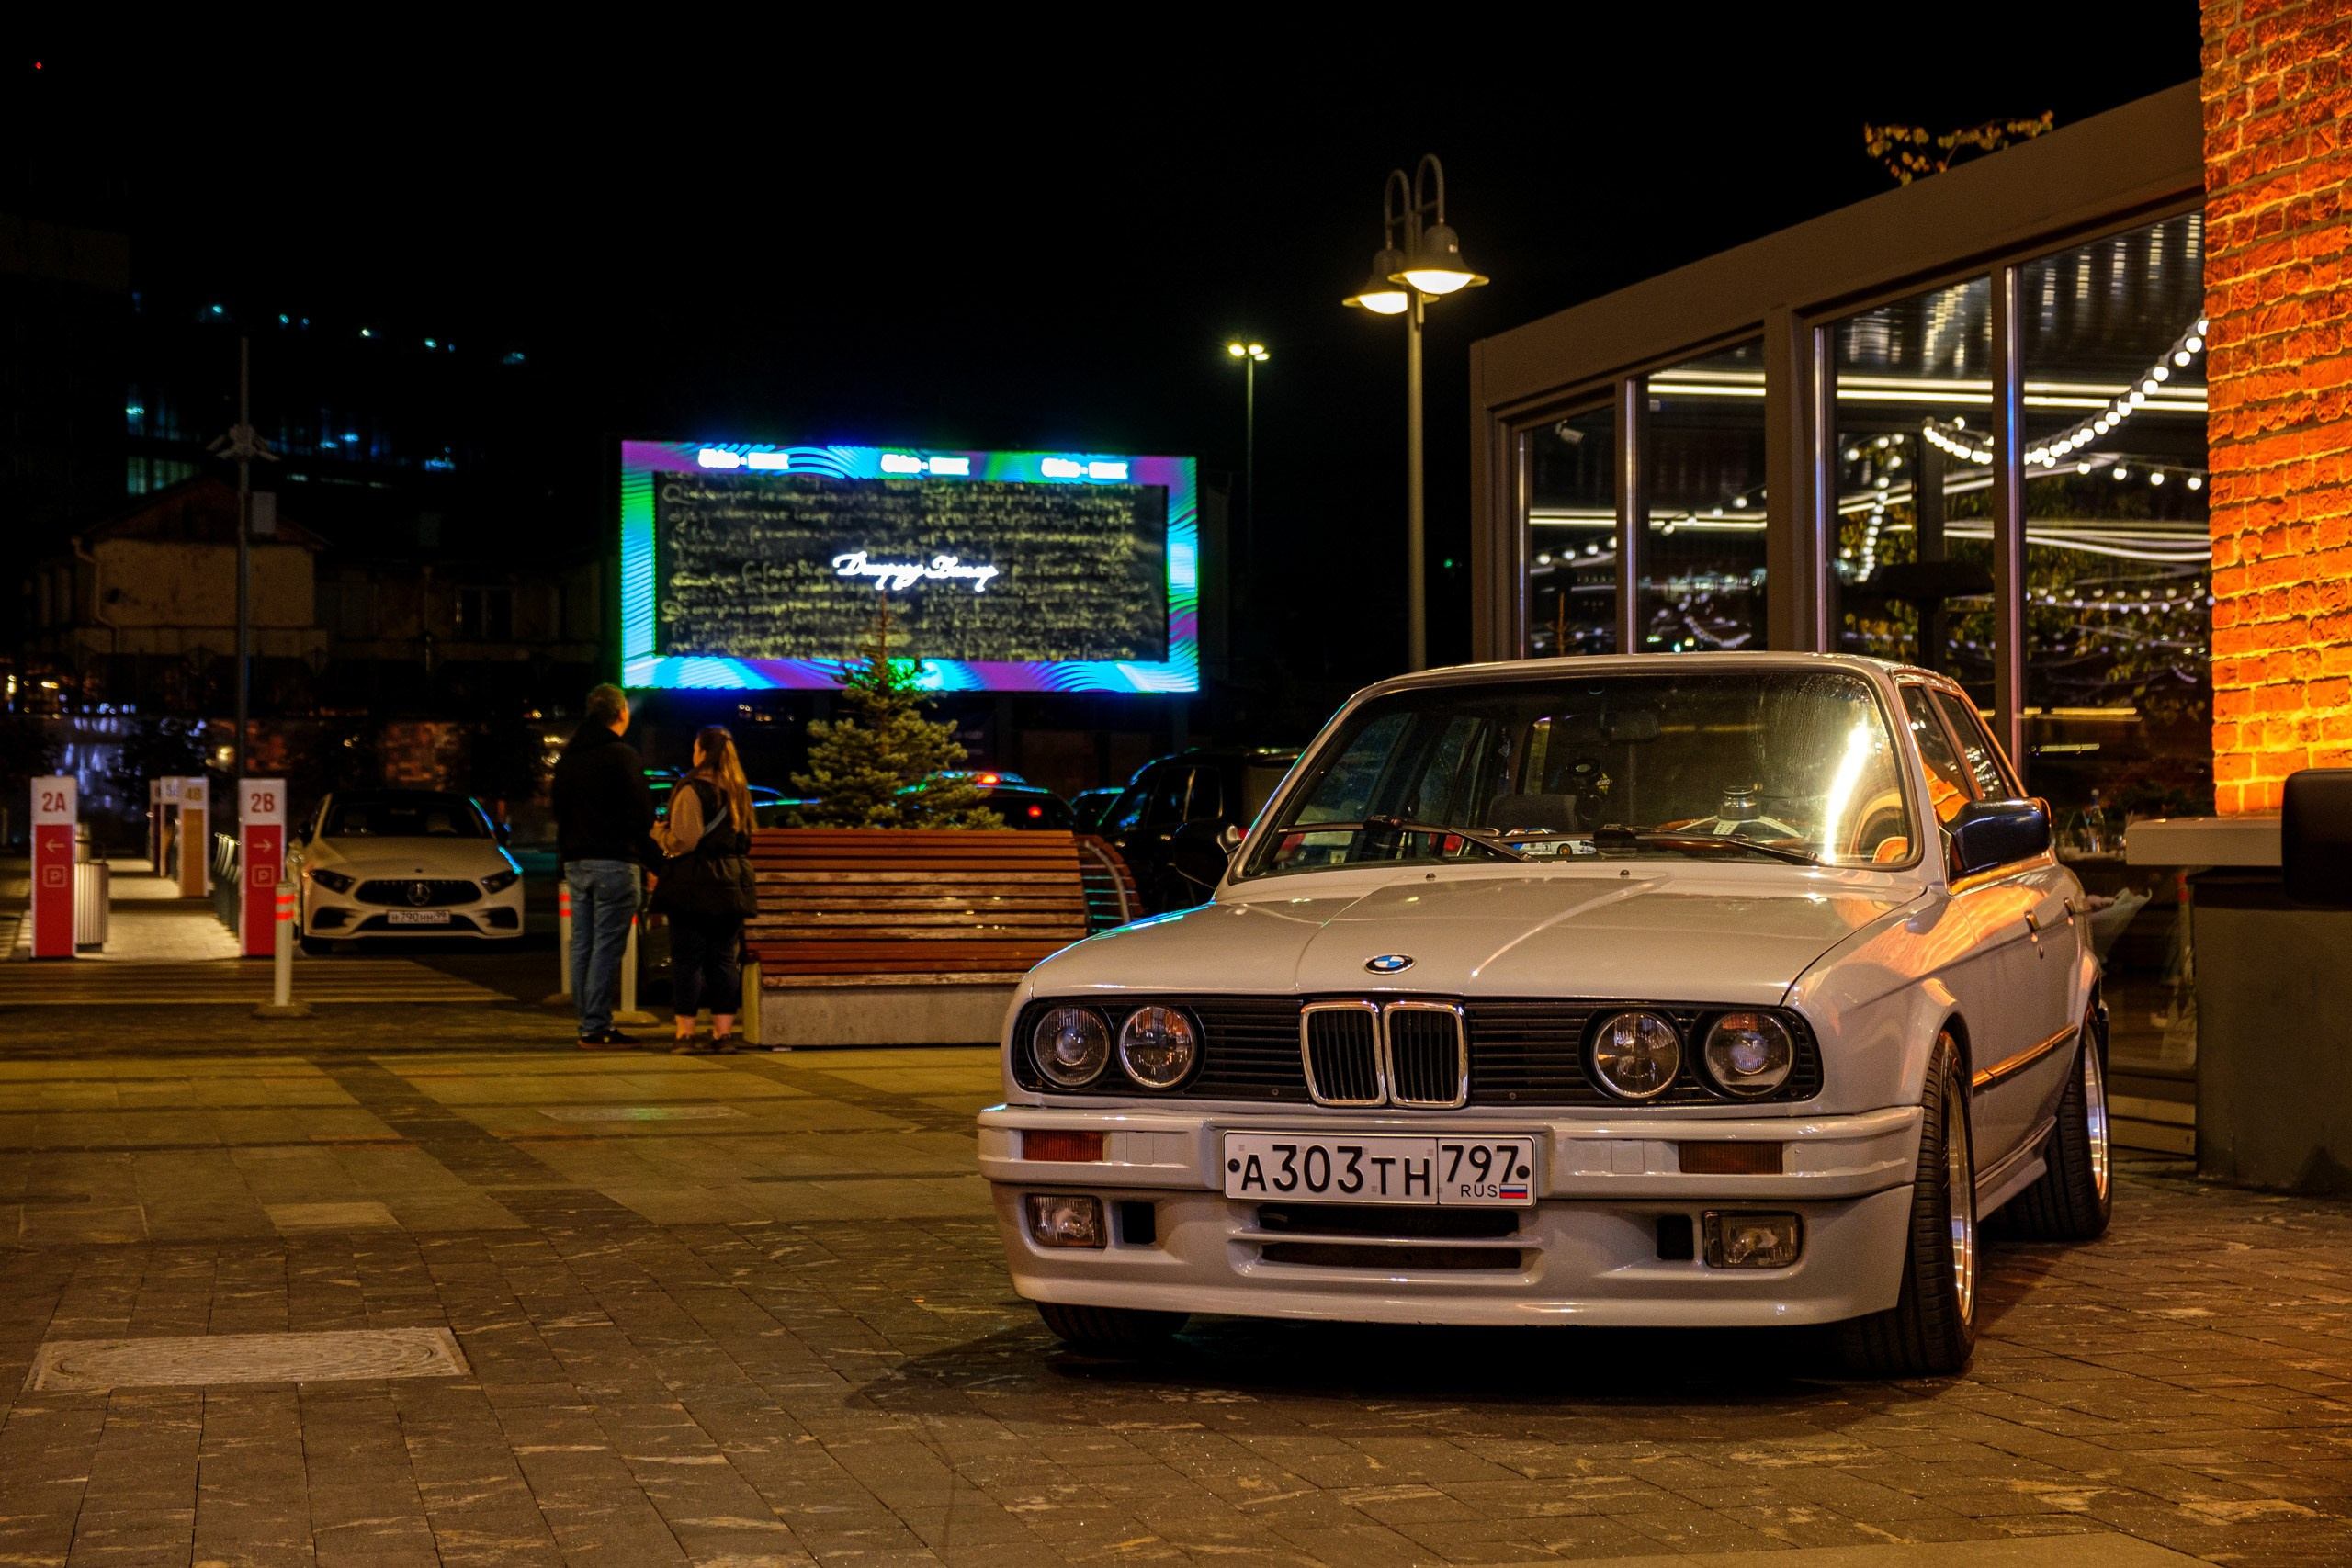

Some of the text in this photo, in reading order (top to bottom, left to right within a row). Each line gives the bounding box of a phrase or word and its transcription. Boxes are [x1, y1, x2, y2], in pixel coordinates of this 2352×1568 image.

[42, 792, 66, 812] 2A
[251, 793, 275, 812] 2B
[1240, 1144, 1519, 1196] А303ТН 797
[1460, 1183, 1498, 1198] RUS
